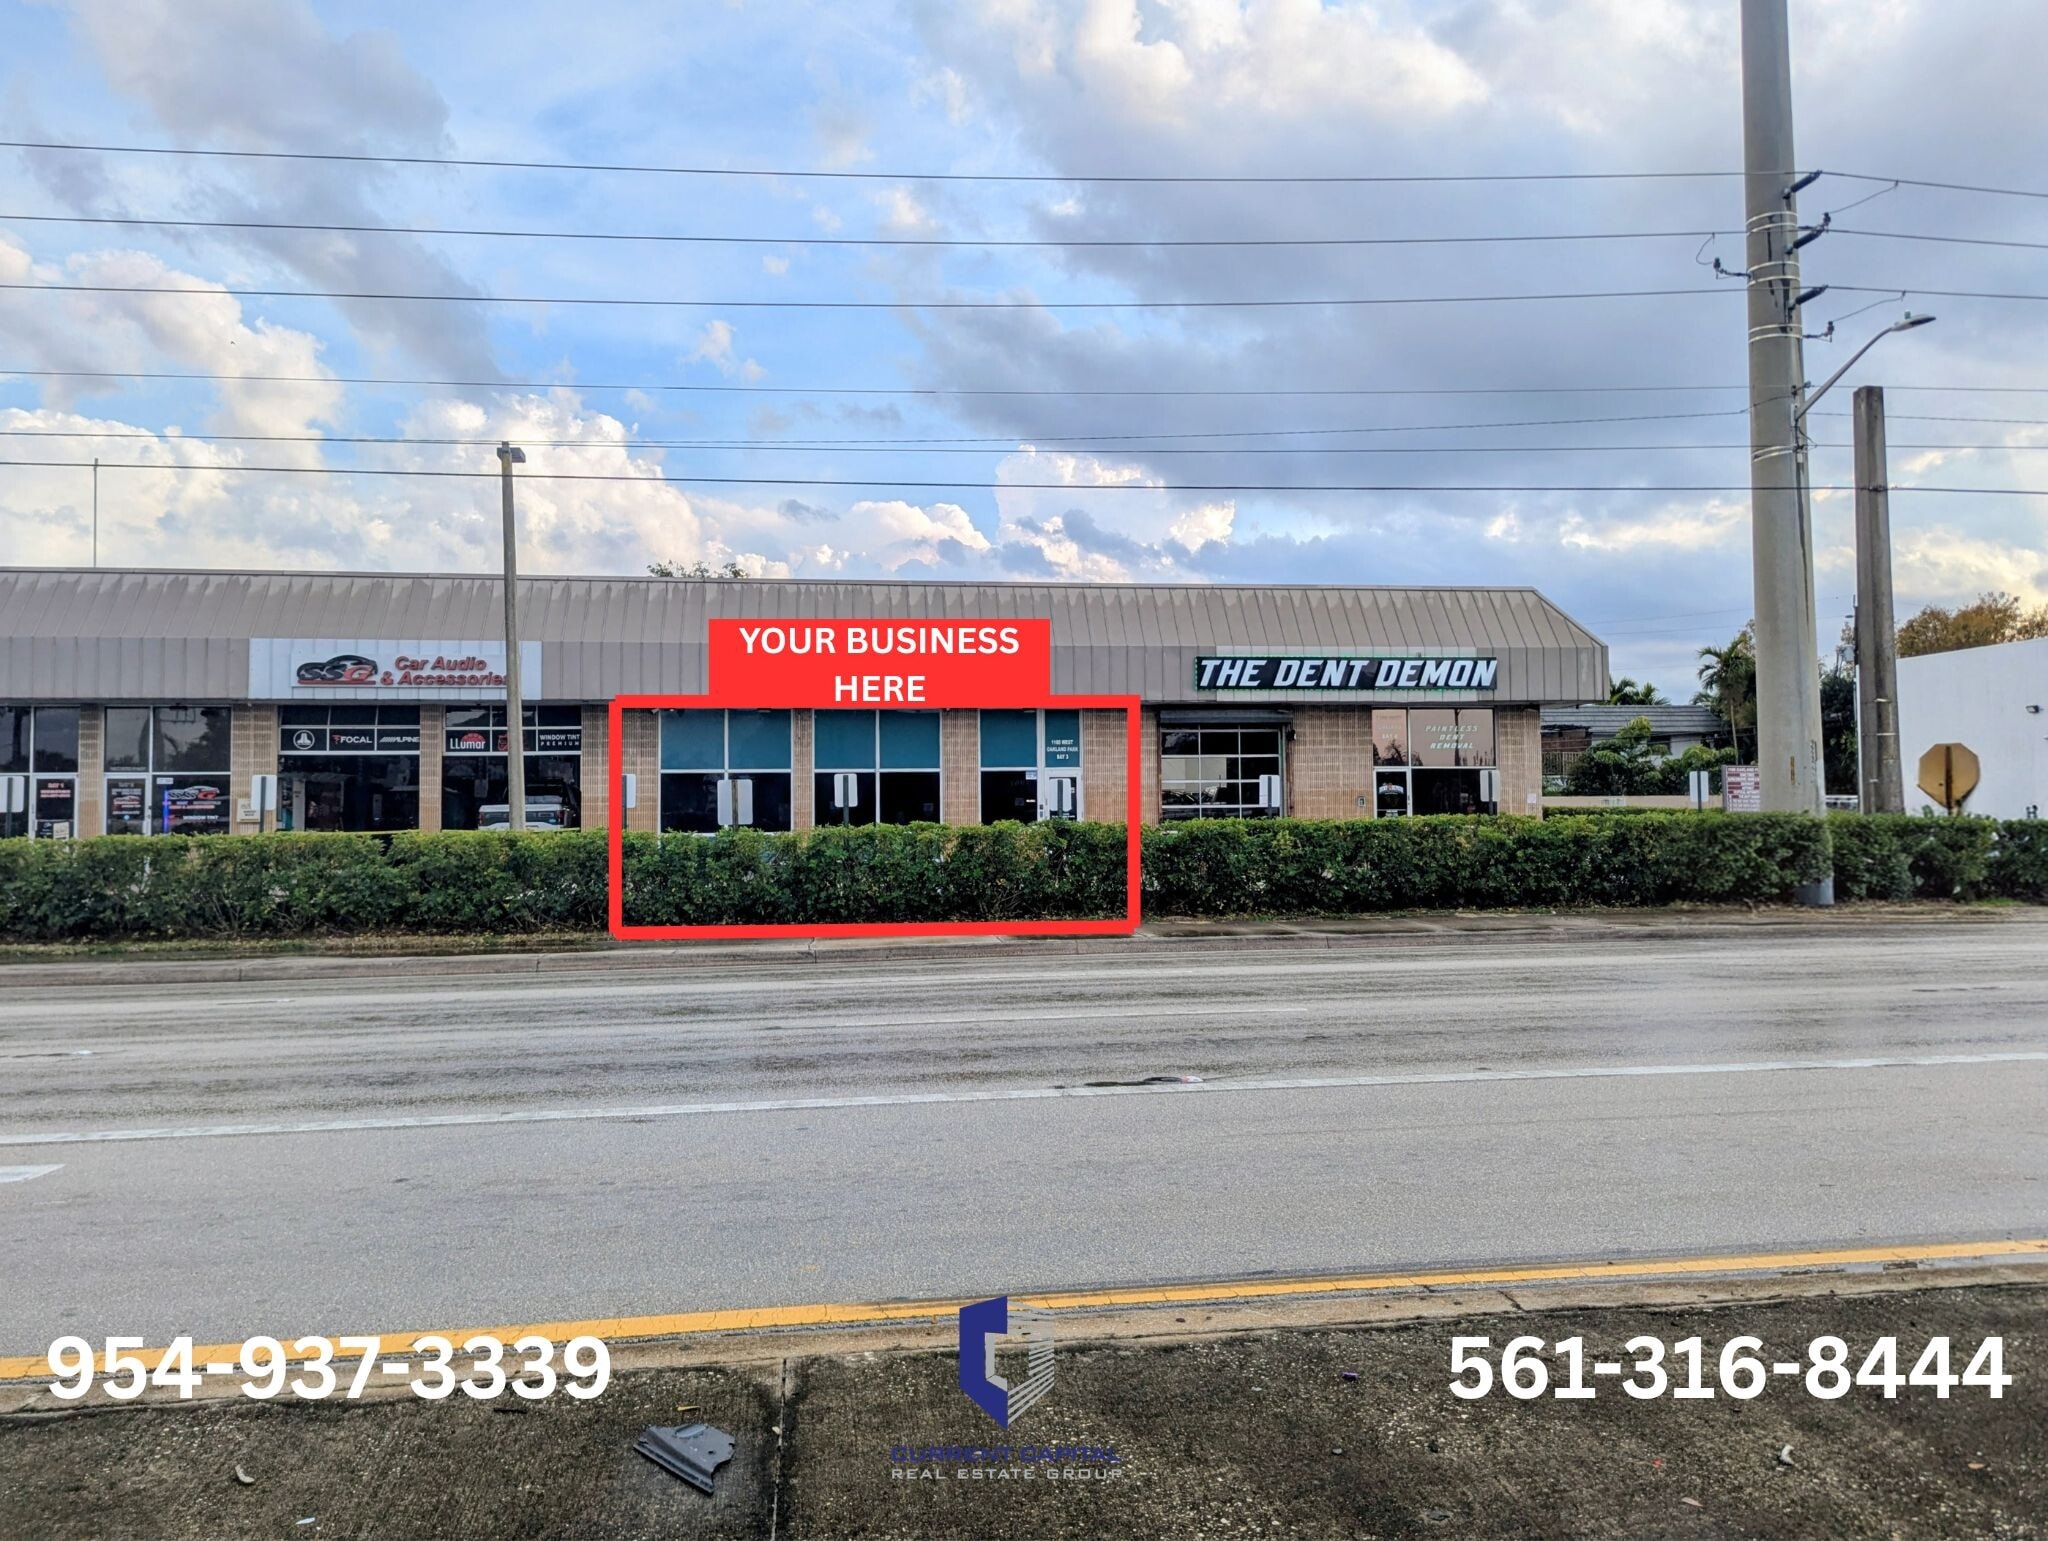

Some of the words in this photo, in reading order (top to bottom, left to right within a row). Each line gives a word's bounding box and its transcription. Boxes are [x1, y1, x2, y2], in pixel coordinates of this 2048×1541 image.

[395, 656, 429, 671] Car
[431, 656, 487, 671] Audio
[380, 671, 394, 685] &
[1199, 659, 1268, 687] THE
[1273, 659, 1370, 687] DENT
[1375, 659, 1498, 687] DEMON
[340, 736, 373, 744] FOCAL
[1439, 733, 1466, 741] DENT
[449, 738, 486, 750] LLumar
